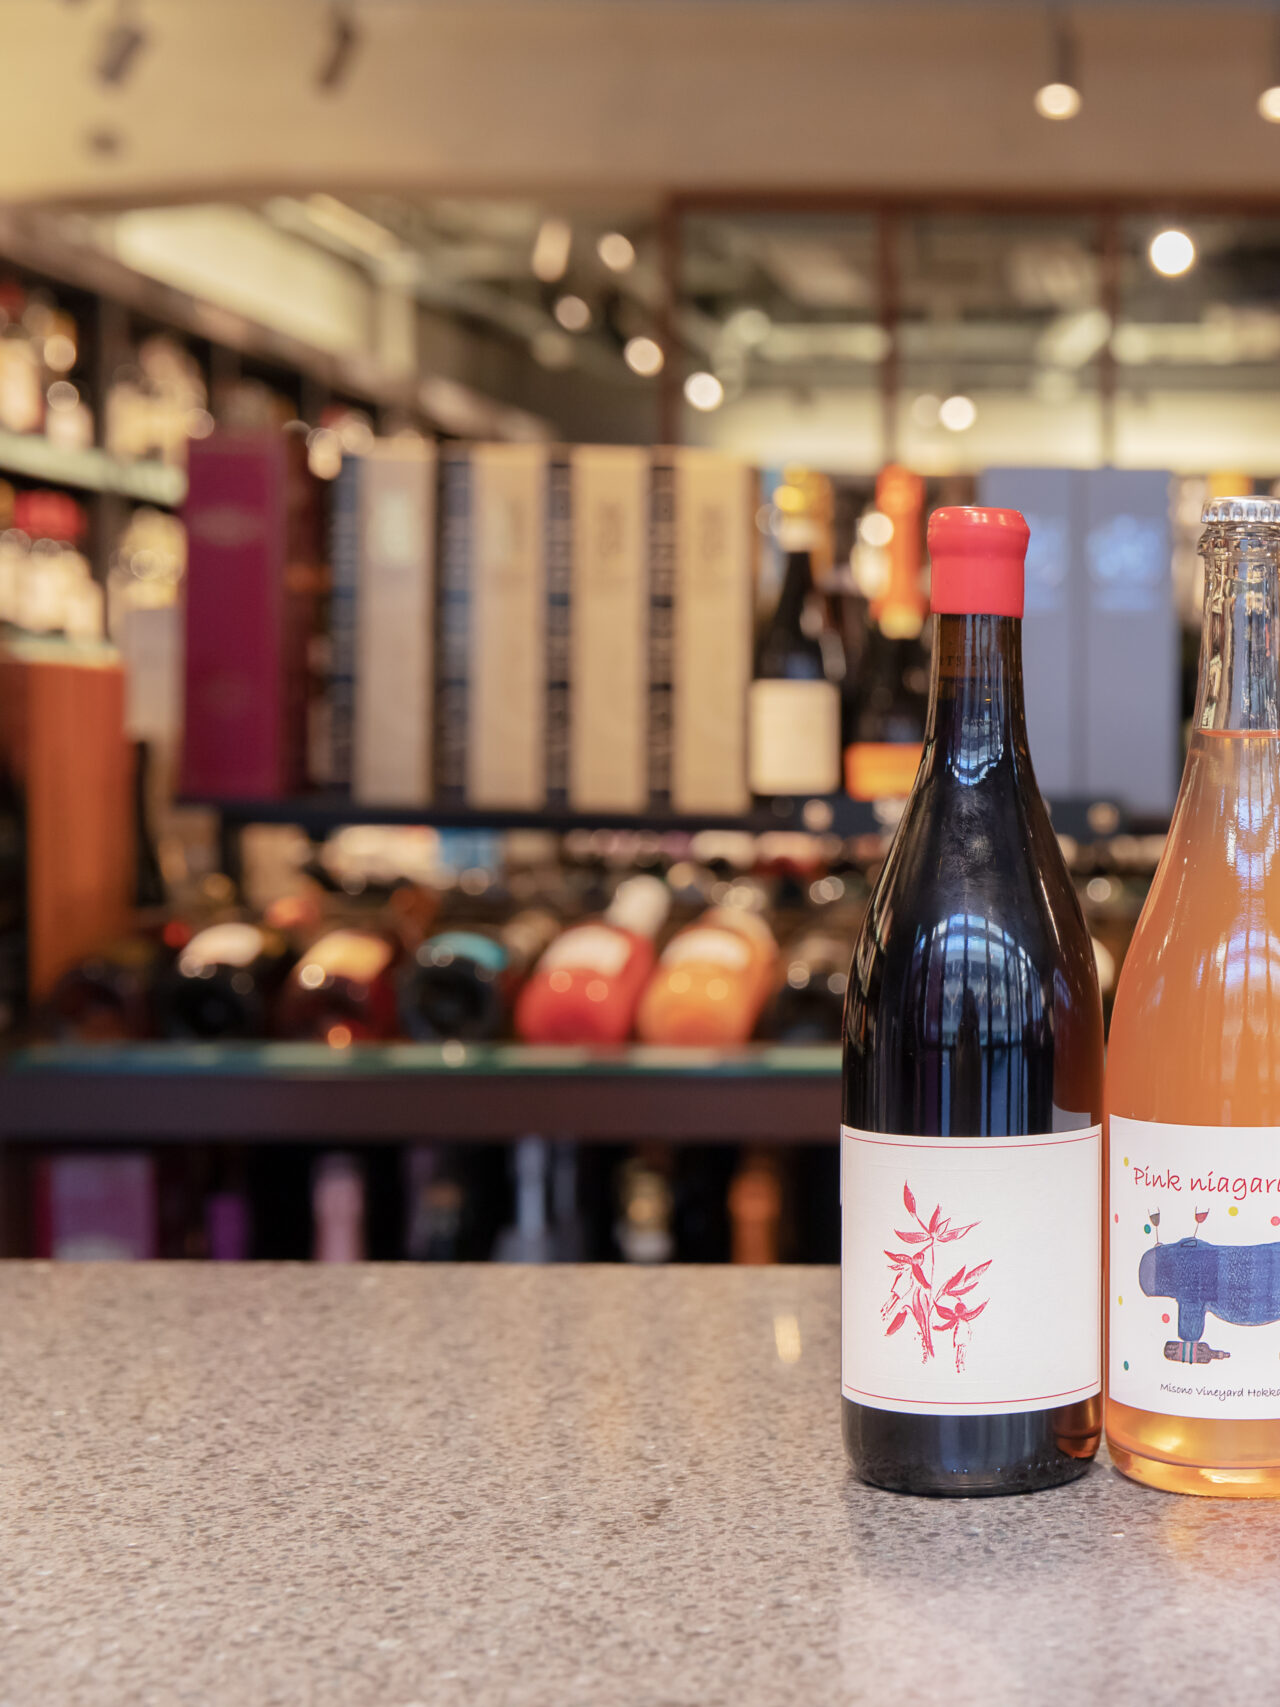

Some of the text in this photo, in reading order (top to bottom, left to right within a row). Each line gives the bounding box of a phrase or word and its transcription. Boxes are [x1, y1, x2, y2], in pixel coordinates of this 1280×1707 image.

[1133, 1166, 1182, 1191] Pink
[1159, 1383, 1193, 1395] Misono
[1195, 1387, 1244, 1401] Vineyard
